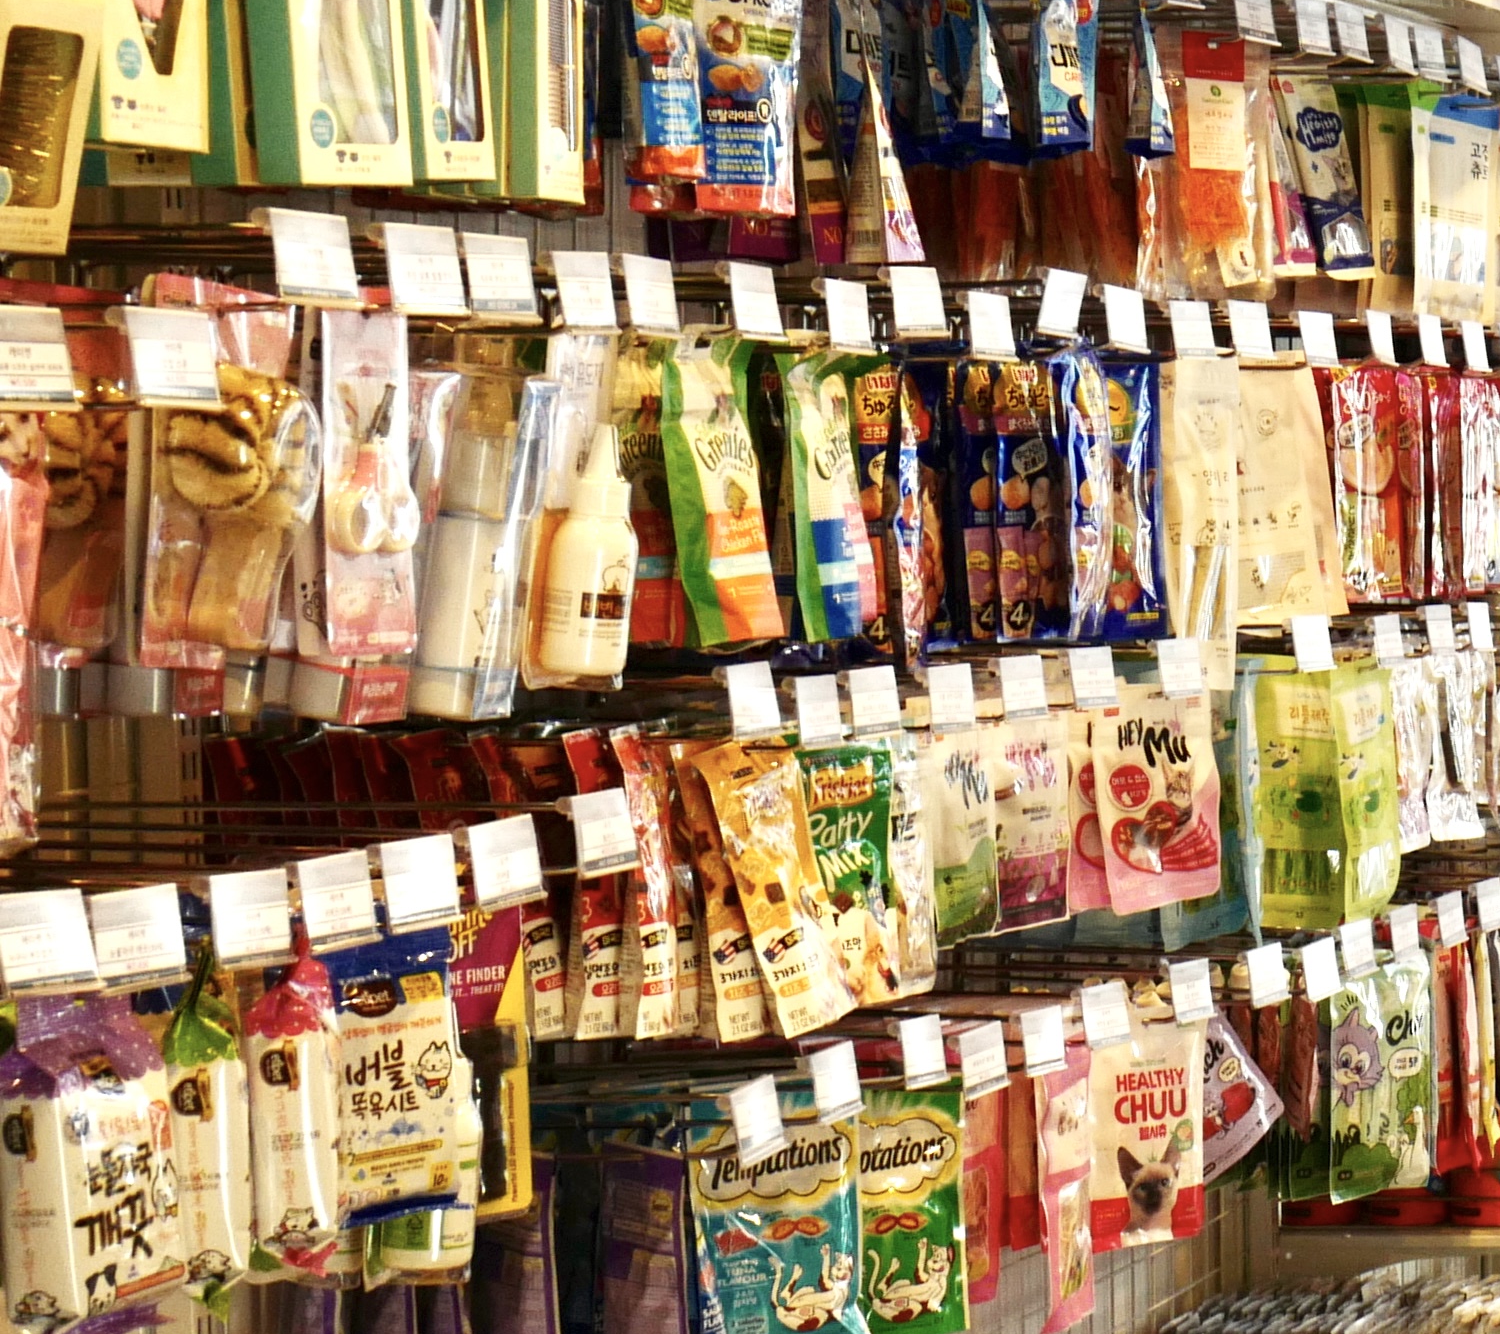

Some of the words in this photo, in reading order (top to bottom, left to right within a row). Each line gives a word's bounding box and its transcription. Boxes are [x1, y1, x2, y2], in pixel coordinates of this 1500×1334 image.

[696, 424, 756, 470] Greenies
[1117, 719, 1143, 751] HEY
[1144, 726, 1190, 767] Mu
[807, 811, 872, 843] Party
[821, 846, 870, 880] Mix
[462, 966, 506, 985] FINDER
[346, 1039, 411, 1087] 버블
[1116, 1069, 1185, 1092] HEALTHY
[1115, 1088, 1186, 1125] CHUU
[75, 1189, 154, 1258] 깨끗
